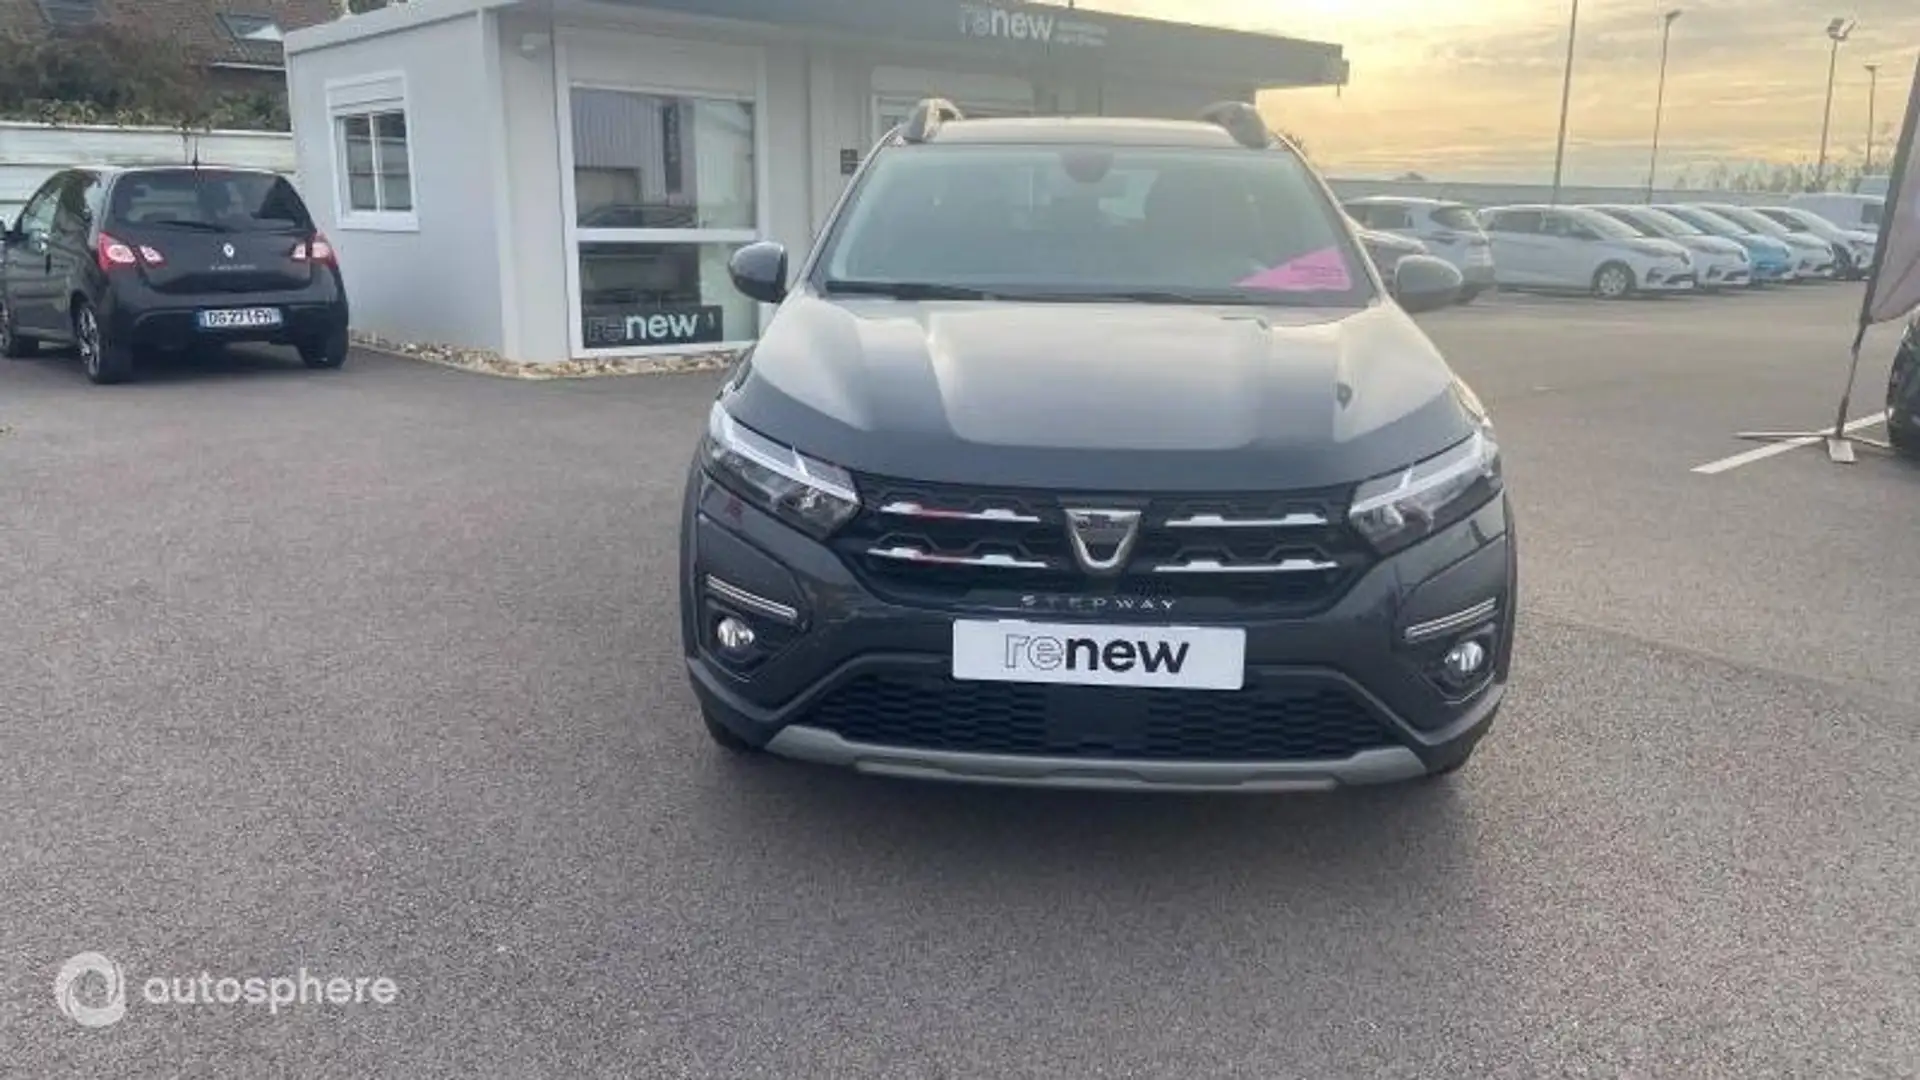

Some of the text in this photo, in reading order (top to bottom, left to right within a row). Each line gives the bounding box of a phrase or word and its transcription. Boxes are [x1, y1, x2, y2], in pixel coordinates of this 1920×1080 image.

[960, 5, 1053, 41] renew
[1021, 594, 1175, 610] STEPWAY
[1005, 634, 1189, 673] renew
